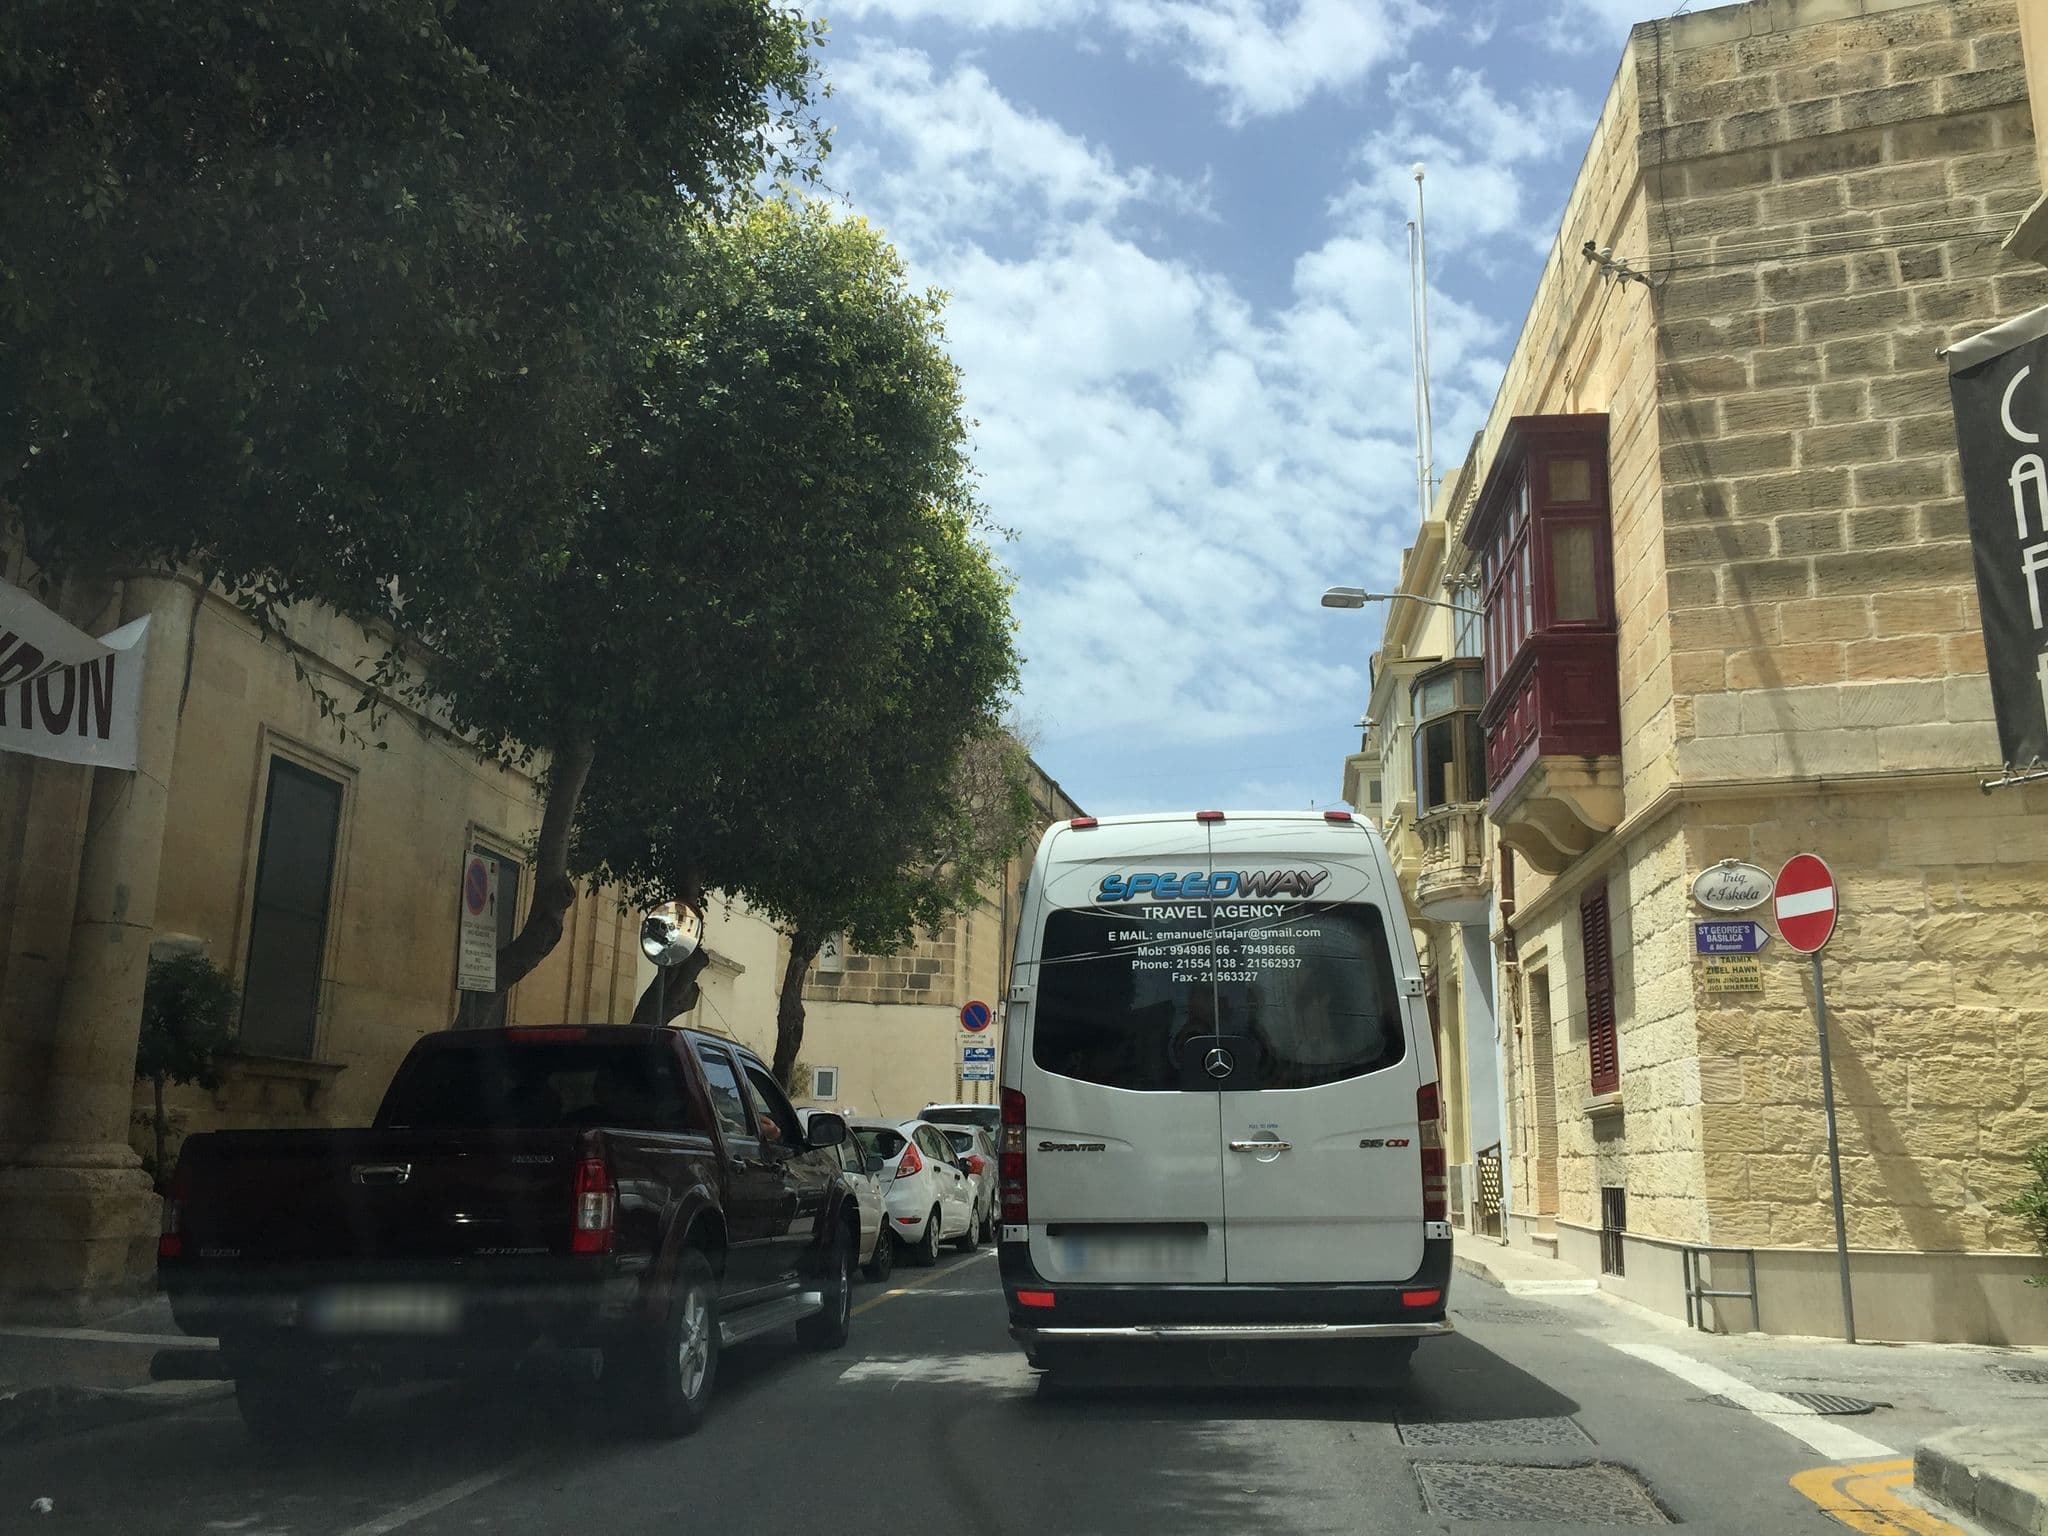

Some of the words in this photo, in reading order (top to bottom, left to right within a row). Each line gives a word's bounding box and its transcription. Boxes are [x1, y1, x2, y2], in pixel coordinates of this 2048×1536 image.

[1720, 871, 1747, 885] Triq
[1096, 870, 1327, 902] SPEEDWAY
[1141, 906, 1207, 919] TRAVEL
[1213, 904, 1285, 918] AGENCY
[1108, 931, 1116, 941] E
[1120, 930, 1153, 940] MAIL:
[1698, 926, 1708, 935] ST
[1710, 925, 1750, 934] GEORGE'S
[1706, 934, 1743, 943] BASILICA
[1137, 946, 1166, 956] Mob:
[1240, 945, 1296, 955] 79498666
[1132, 960, 1173, 970] Phone:
[1247, 958, 1302, 968] 21562937
[1719, 955, 1752, 964] TARMIX
[1732, 966, 1758, 974] HAWN
[1385, 1139, 1410, 1148] CDI
